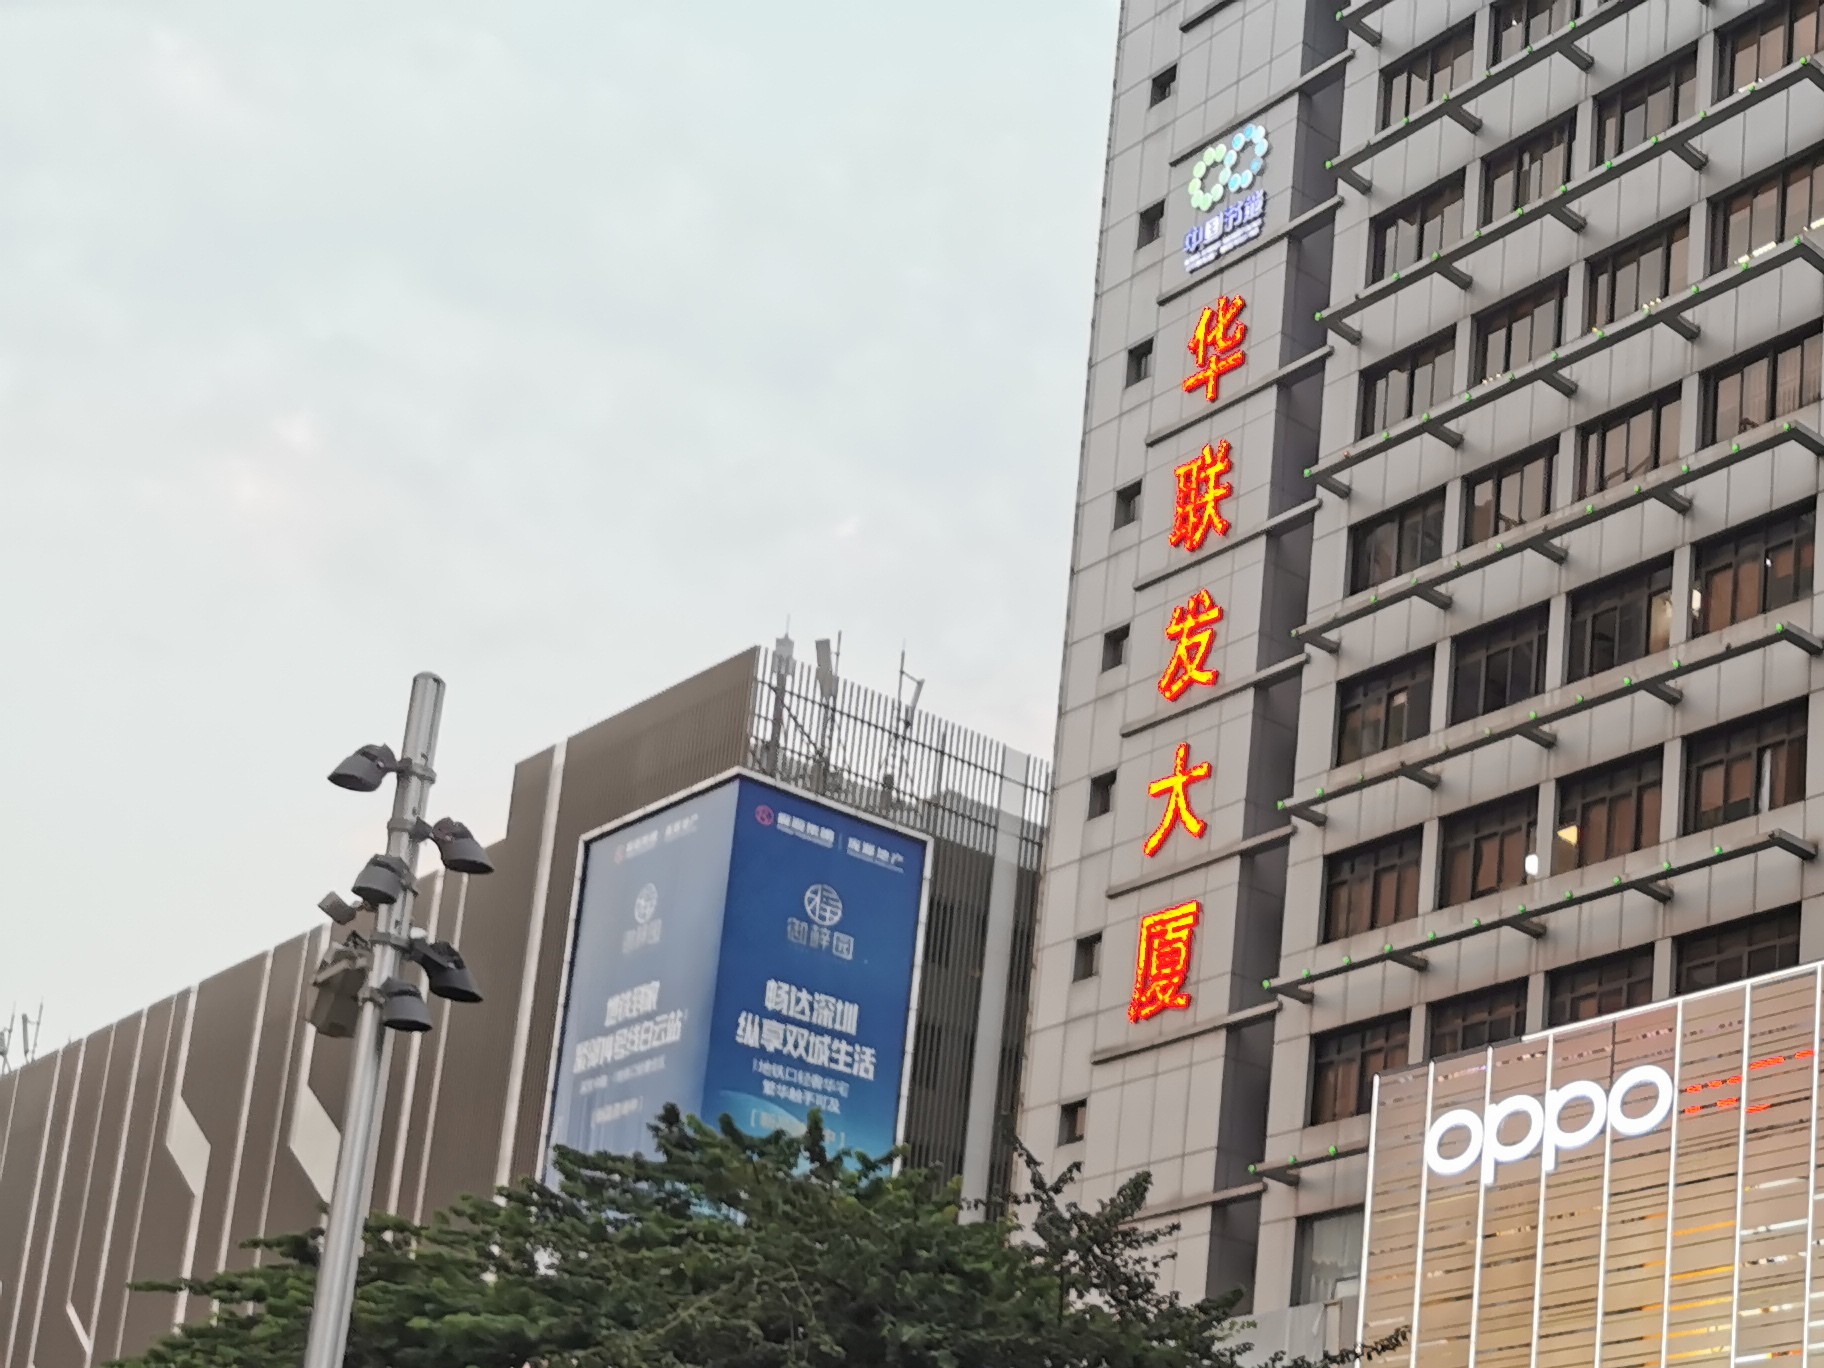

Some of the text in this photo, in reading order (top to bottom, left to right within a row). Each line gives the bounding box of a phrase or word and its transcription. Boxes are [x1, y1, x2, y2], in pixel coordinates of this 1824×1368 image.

[1184, 189, 1265, 252] 中国节能
[1128, 294, 1248, 1024] 华联发大厦
[765, 978, 860, 1037] 畅达深圳
[735, 1010, 877, 1081] 纵享双城生活
[1425, 1064, 1675, 1183] oppo
